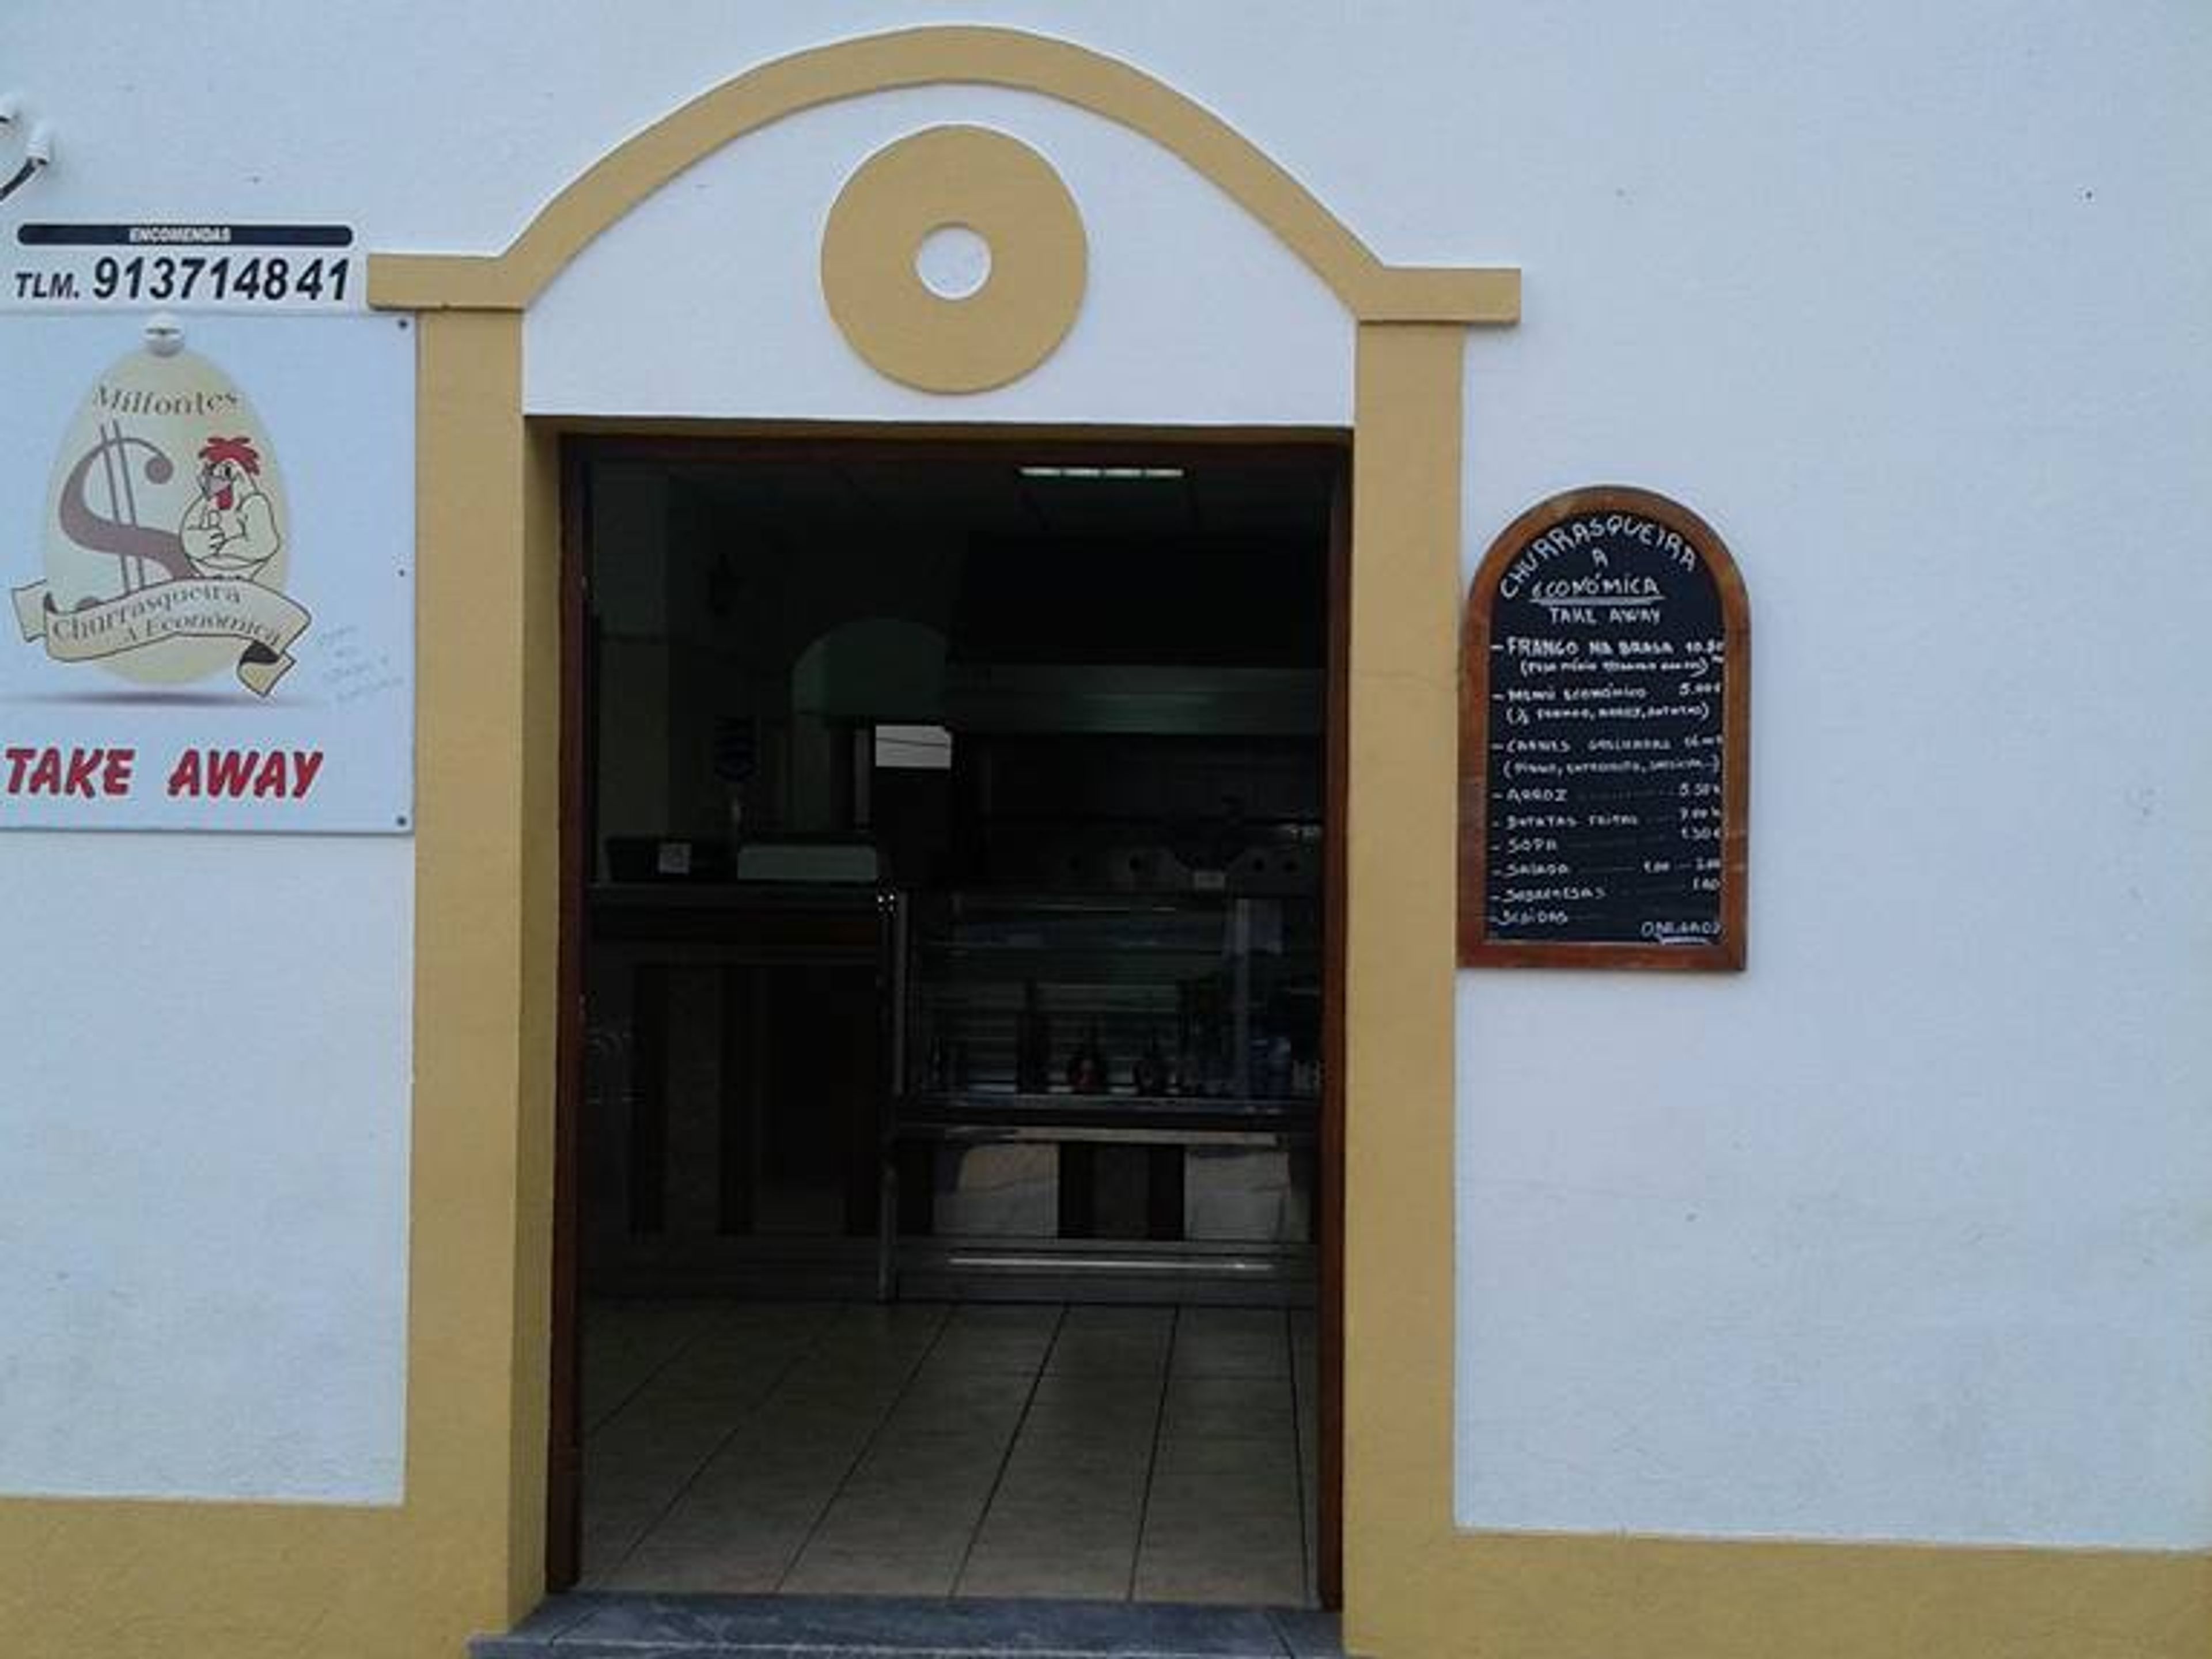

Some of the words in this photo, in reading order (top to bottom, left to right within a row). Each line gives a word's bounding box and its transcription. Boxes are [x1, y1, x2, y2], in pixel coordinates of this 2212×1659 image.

[129, 228, 231, 243] ENCOMENDAS
[15, 273, 79, 298] TLM.
[93, 257, 349, 301] 913714841
[93, 385, 237, 416] Milfontes
[1500, 515, 1695, 598] CHURRASQUEIRA
[1592, 548, 1608, 567] A
[52, 584, 241, 641] Churrasqueira
[1550, 607, 1597, 624] TAKE
[1609, 608, 1660, 624] AWAY
[1507, 637, 1578, 657] FRANGO
[5, 748, 135, 800] TAKE
[166, 749, 323, 798] AWAY
